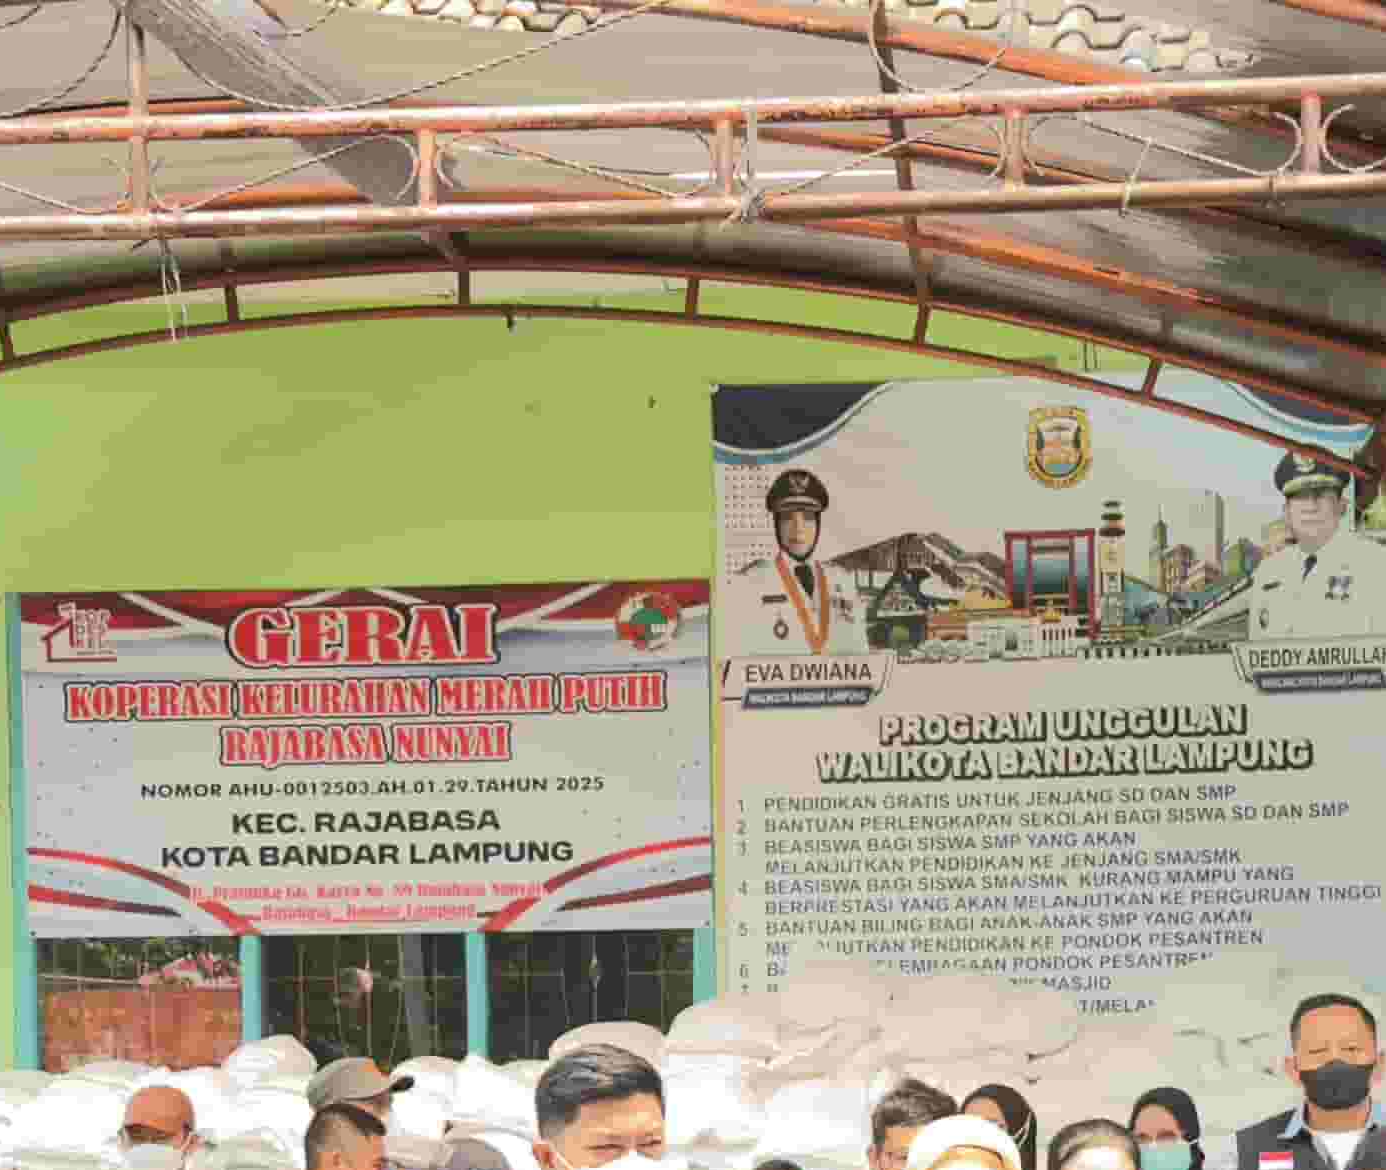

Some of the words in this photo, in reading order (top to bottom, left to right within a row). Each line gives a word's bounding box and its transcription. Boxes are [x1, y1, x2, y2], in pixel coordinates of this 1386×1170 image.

[226, 604, 498, 667] GERAI
[1249, 648, 1301, 668] DEDDY
[745, 664, 784, 682] EVA
[790, 663, 871, 681] DWIANA
[66, 682, 233, 721] KOPERASI
[237, 678, 431, 719] KELURAHAN
[436, 674, 554, 715] MERAH
[559, 671, 666, 712] PUTIH
[878, 711, 1047, 746] PROGRAM
[1053, 703, 1248, 740] UNGGULAN
[221, 723, 388, 767] RAJABASA
[392, 721, 511, 761] NUNYAI
[816, 750, 992, 783] WALIKOTA
[997, 745, 1138, 778] BANDAR
[1144, 738, 1315, 775] LAMPUNG
[141, 783, 222, 798] NOMOR
[556, 776, 605, 792] 2025
[764, 795, 876, 812] PENDIDIKAN
[882, 793, 950, 810] GRATIS
[956, 791, 1021, 808] UNTUK
[1025, 789, 1112, 806] JENJANG
[1119, 788, 1144, 803] SD
[1150, 787, 1190, 802] DAN
[1197, 785, 1237, 800] SMP
[232, 812, 306, 834] KEC.
[314, 810, 501, 833] RAJABASA
[764, 817, 854, 833] BANTUAN
[860, 812, 1012, 831] PERLENGKAPAN
[1020, 809, 1109, 827] SEKOLAH
[1114, 808, 1161, 825] BAGI
[1167, 807, 1226, 823] SISWA
[1232, 805, 1257, 820] SD
[1263, 804, 1302, 820] DAN
[1309, 801, 1350, 817] SMP
[162, 845, 252, 867] KOTA
[260, 844, 399, 866] BANDAR
[410, 841, 574, 865] LAMPUNG
[764, 838, 861, 855] BEASISWA
[918, 835, 976, 851] SISWA
[1028, 832, 1078, 848] YANG
[1082, 831, 1137, 847] AKAN
[909, 855, 1024, 872] PENDIDIKAN
[1030, 855, 1054, 870] KE
[764, 880, 861, 895] BEASISWA
[918, 876, 976, 892] SISWA
[1080, 869, 1160, 887] KURANG
[1168, 867, 1237, 884] MAMPU
[1243, 865, 1294, 881] YANG
[900, 897, 950, 913] YANG
[954, 896, 1008, 912] AKAN
[765, 920, 856, 936] BANTUAN
[1098, 911, 1137, 928] SMP
[1143, 909, 1194, 926] YANG
[1199, 908, 1253, 925] AKAN
